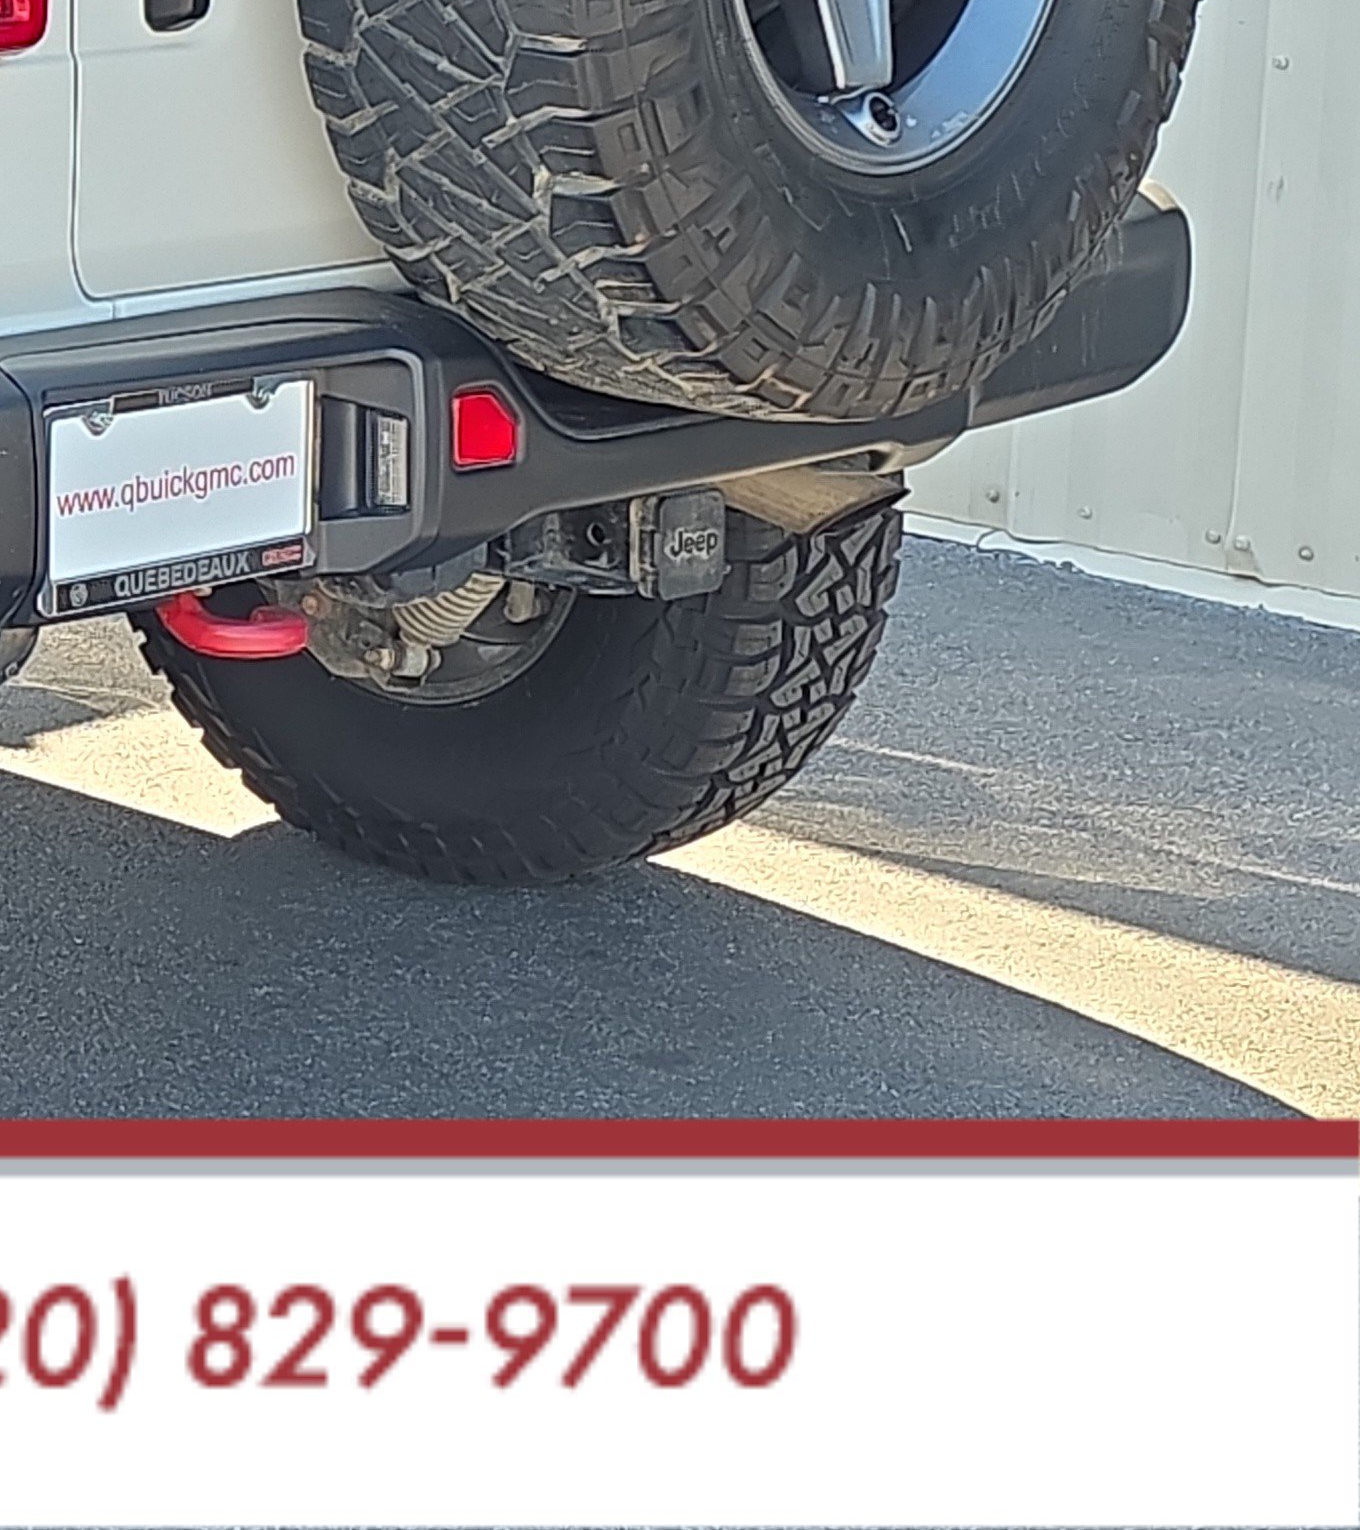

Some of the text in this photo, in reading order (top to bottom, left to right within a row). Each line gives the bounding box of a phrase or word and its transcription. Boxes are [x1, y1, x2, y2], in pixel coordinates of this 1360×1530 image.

[56, 453, 295, 517] www.qbuickgmc.com
[668, 529, 719, 559] Jeep
[113, 550, 250, 598] QUEBEDEAUX
